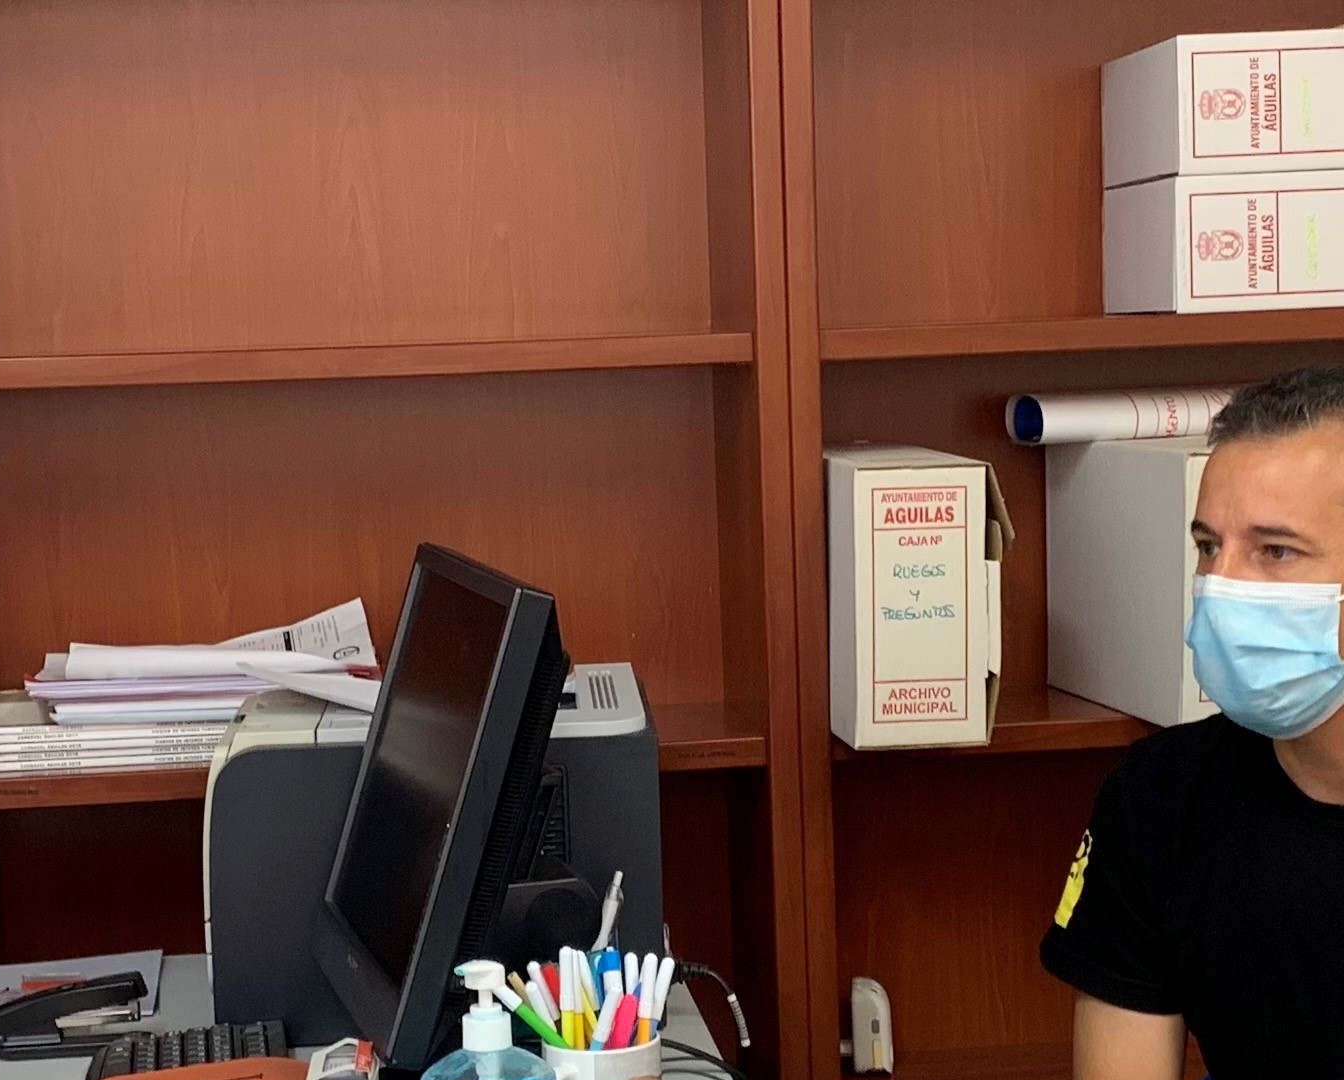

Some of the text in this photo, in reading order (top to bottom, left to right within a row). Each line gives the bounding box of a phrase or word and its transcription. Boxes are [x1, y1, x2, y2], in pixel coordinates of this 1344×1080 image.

[1249, 57, 1261, 150] AYUNTAMIENTO DE
[1261, 72, 1277, 133] ÁGUILAS
[1247, 198, 1258, 290] AYUNTAMIENTO DE
[1258, 213, 1274, 273] ÁGUILAS
[881, 491, 958, 503] AYUNTAMIENTO DE
[884, 505, 955, 524] AGUILAS
[898, 536, 928, 547] CAJA
[892, 563, 946, 579] RUEGOS
[880, 604, 956, 621] PREGUNTAS
[887, 686, 951, 701] ARCHIVO
[881, 700, 958, 716] MUNICIPAL
